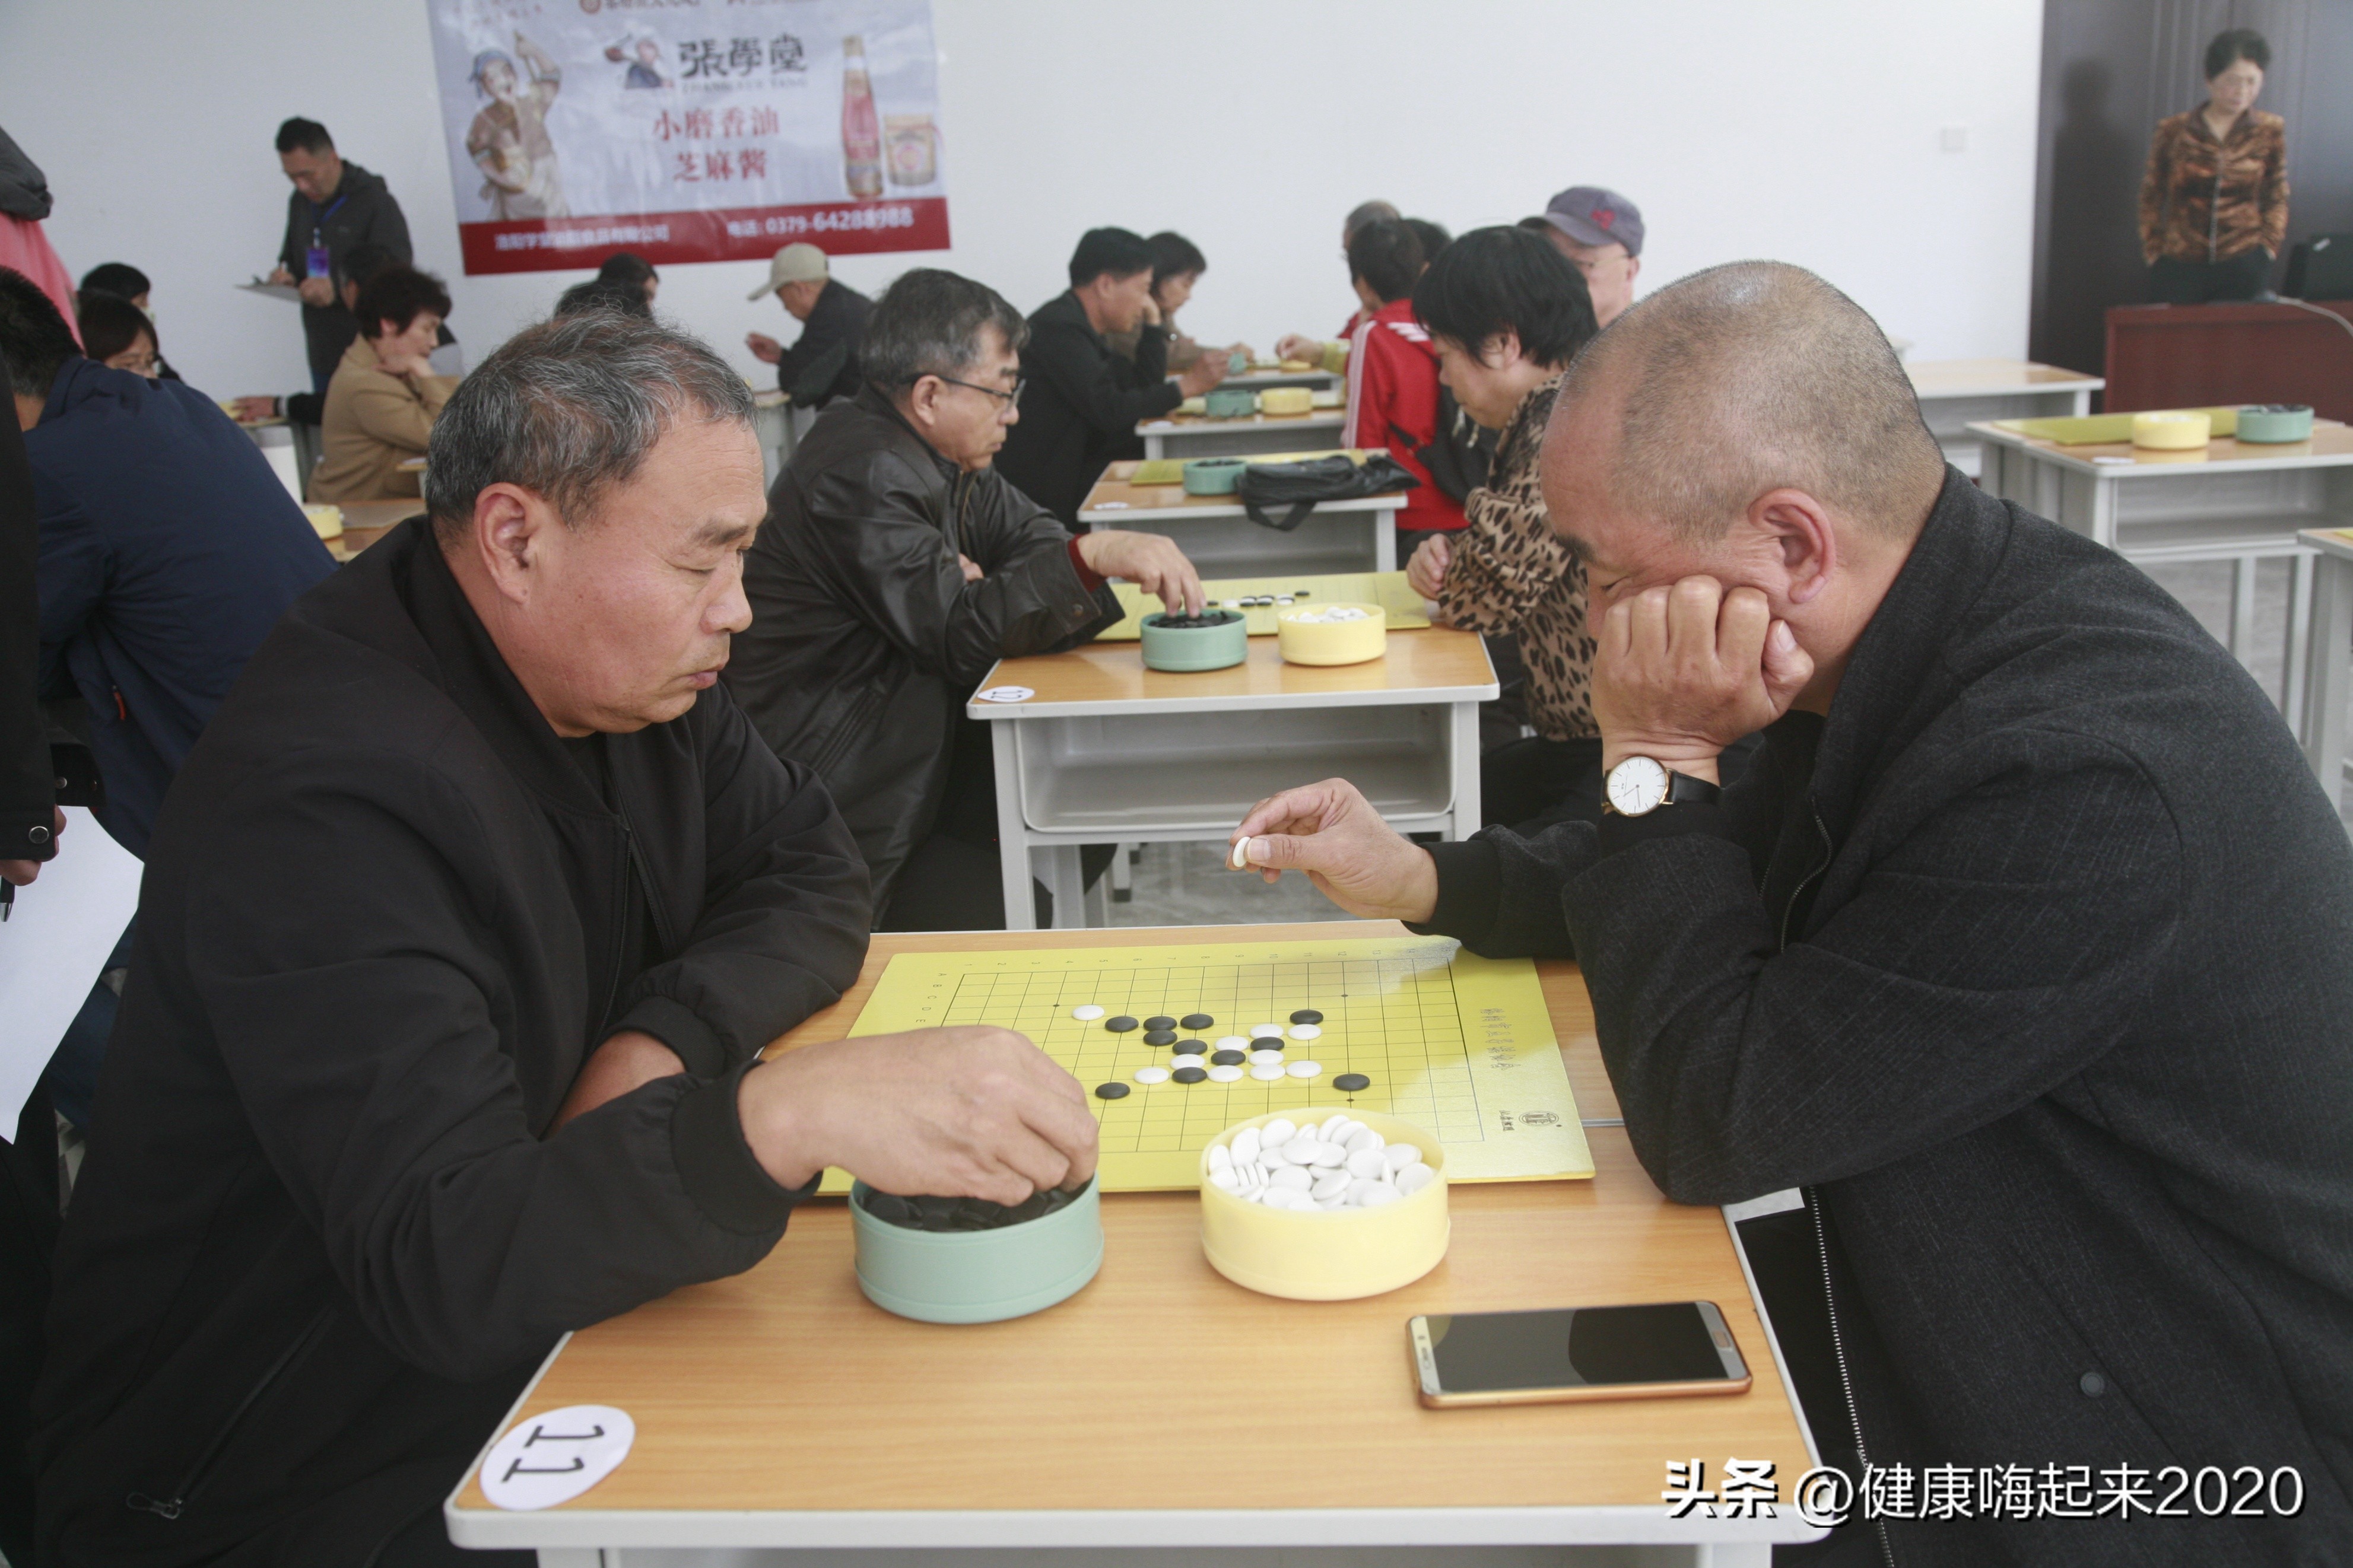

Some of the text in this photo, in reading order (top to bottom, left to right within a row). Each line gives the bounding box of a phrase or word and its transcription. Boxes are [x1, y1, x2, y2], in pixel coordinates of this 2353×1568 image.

[653, 106, 779, 141] 小磨香油
[673, 148, 767, 182] 芝麻酱
[501, 1424, 605, 1483] 11
